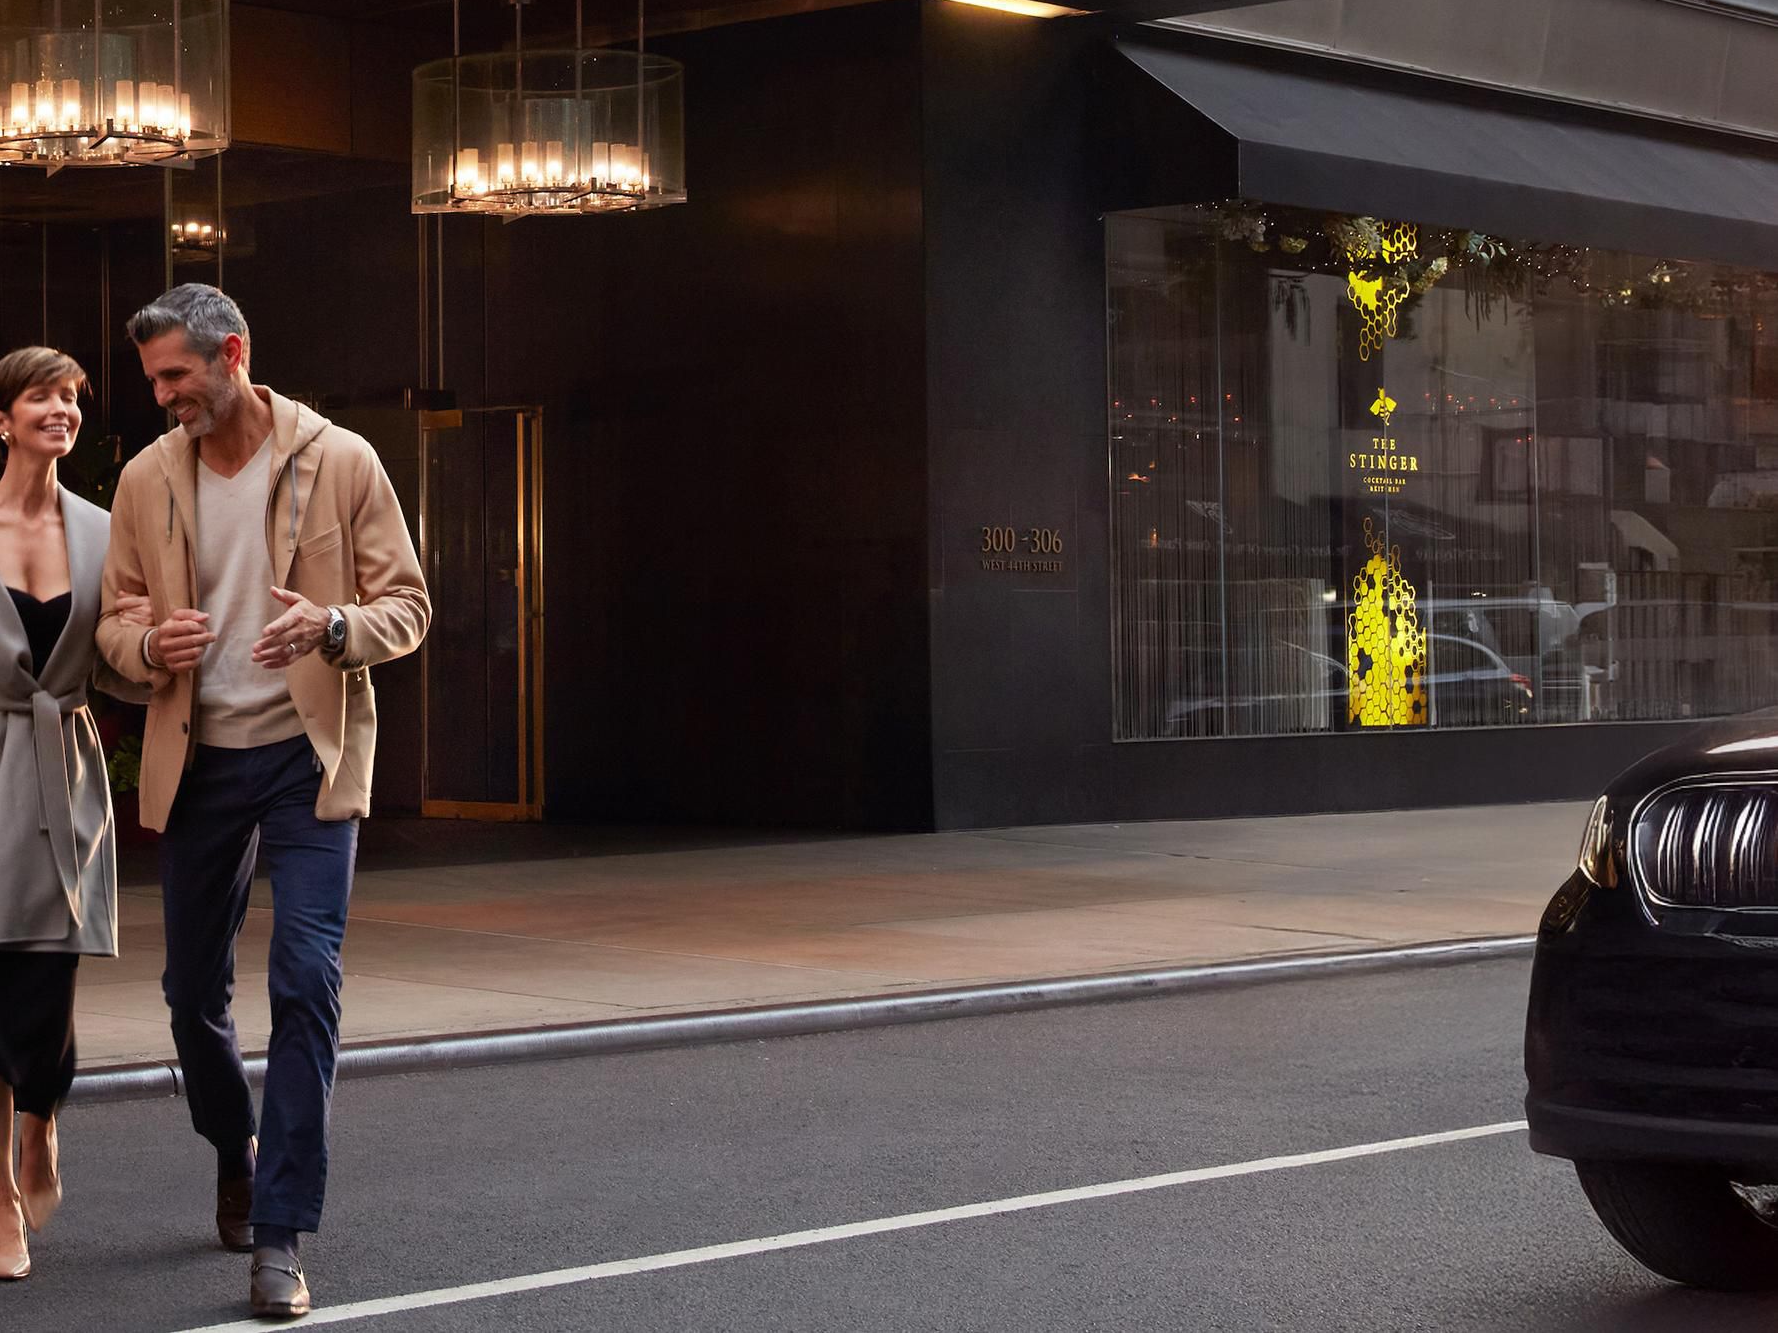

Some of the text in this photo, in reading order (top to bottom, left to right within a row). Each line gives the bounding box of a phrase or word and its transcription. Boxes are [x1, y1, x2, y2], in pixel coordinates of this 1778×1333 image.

[1372, 437, 1396, 451] THE
[1349, 453, 1418, 471] STINGER
[982, 560, 1005, 571] WEST
[1032, 560, 1062, 572] STREET
